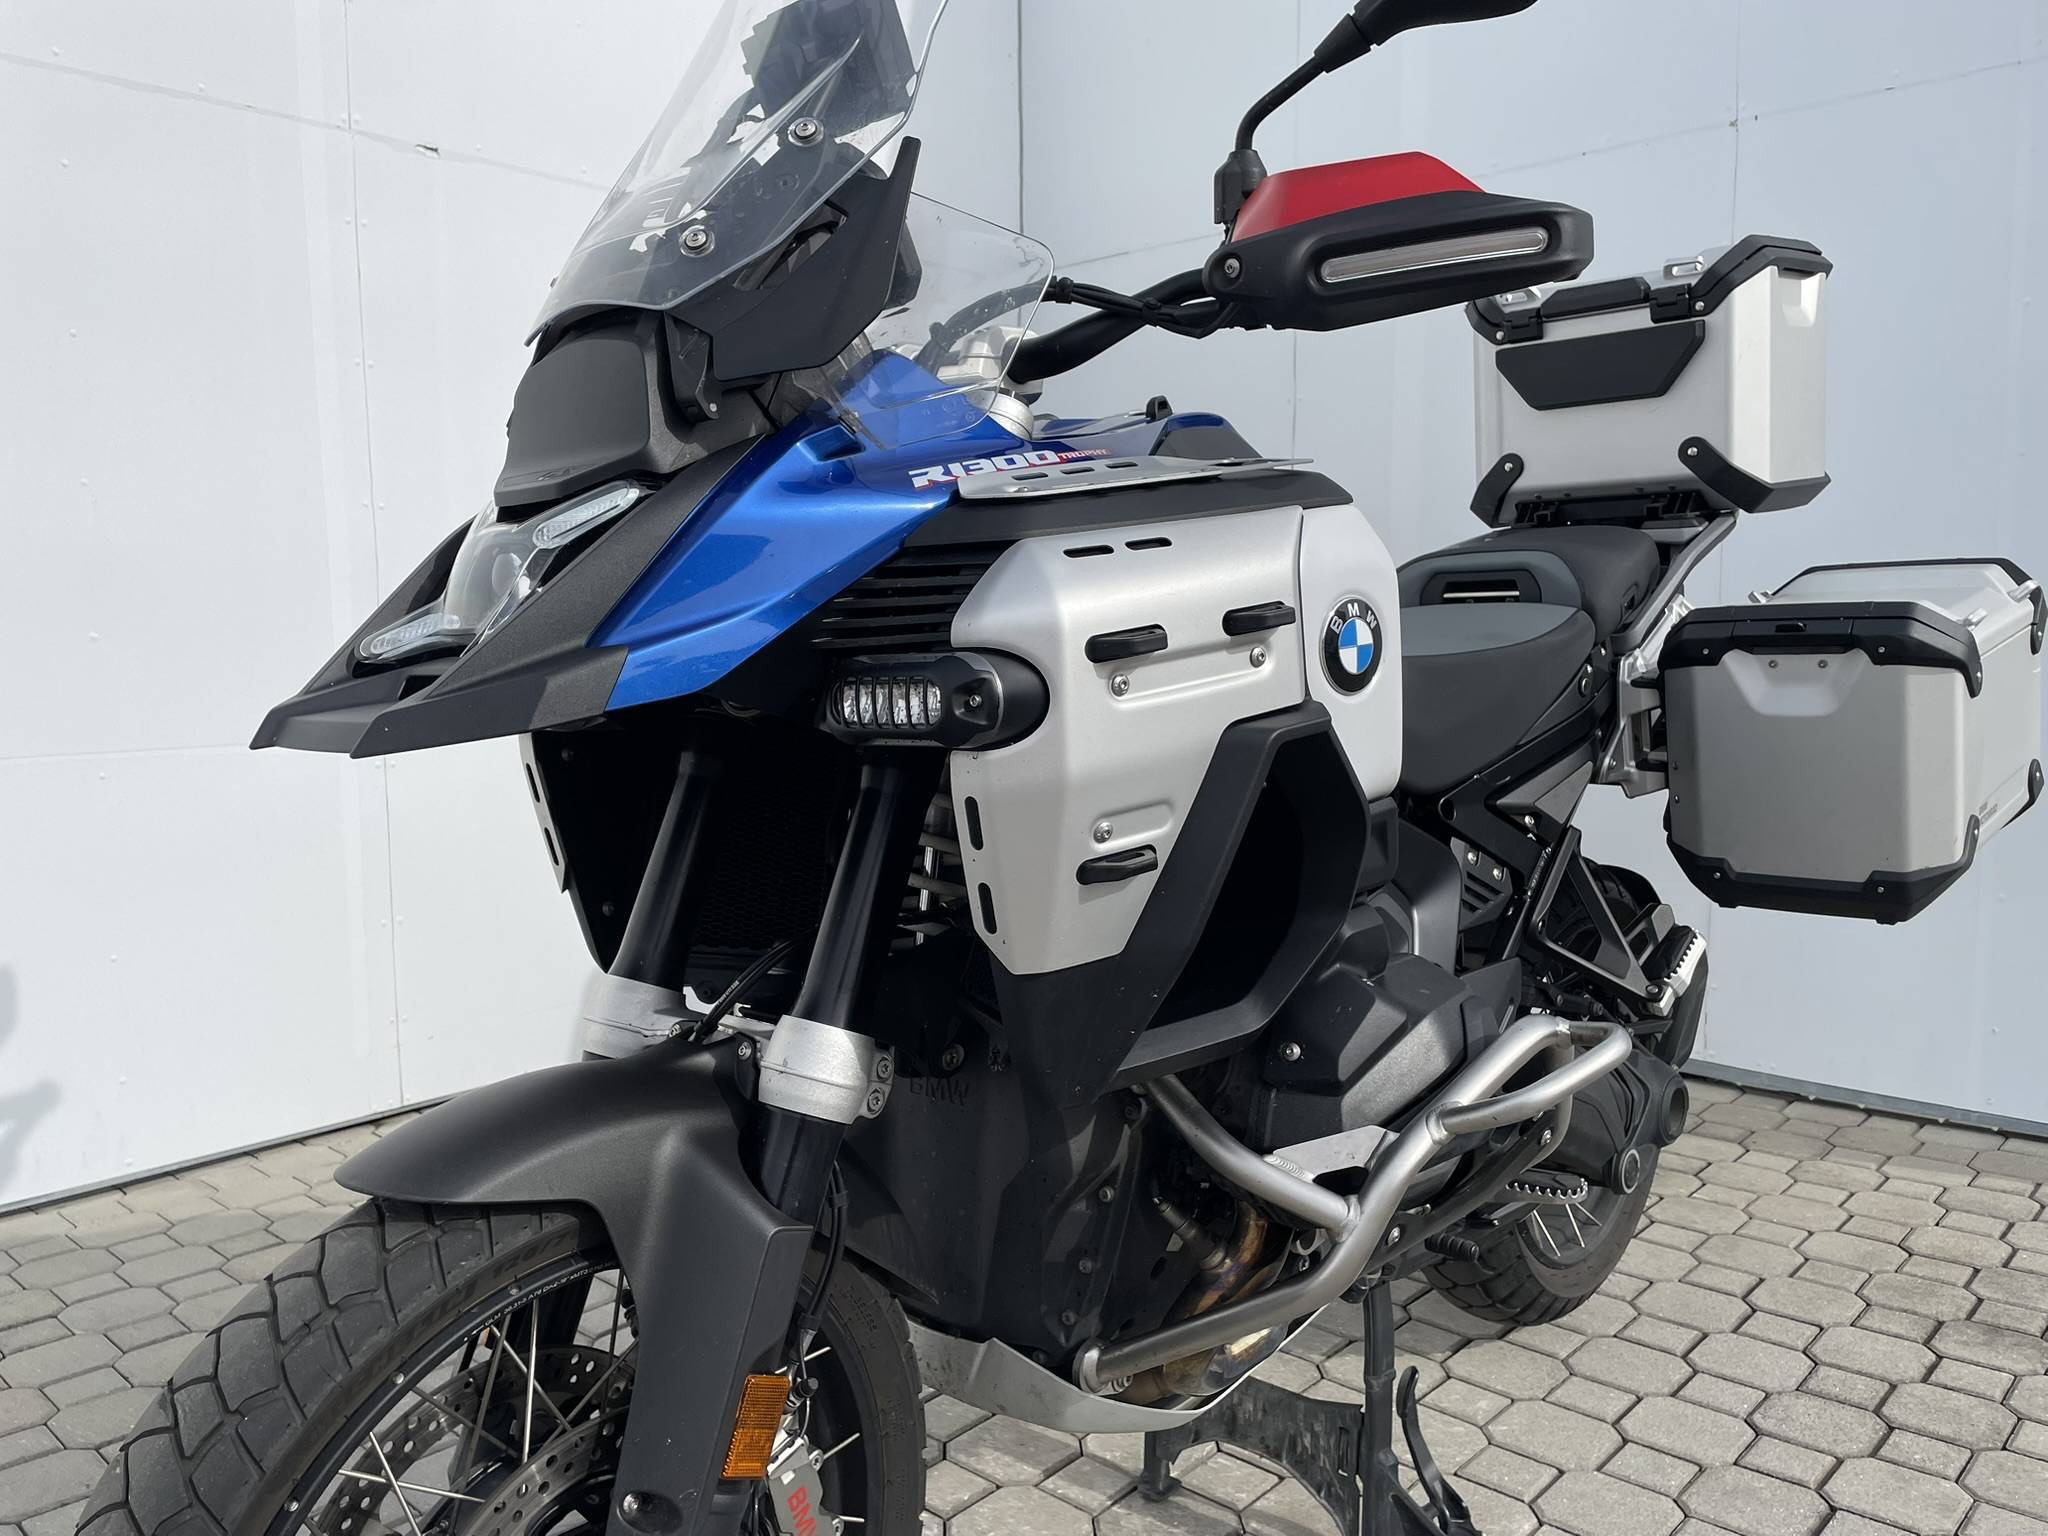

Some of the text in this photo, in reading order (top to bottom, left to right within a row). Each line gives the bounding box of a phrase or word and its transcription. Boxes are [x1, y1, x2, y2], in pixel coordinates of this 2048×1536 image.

[908, 449, 1062, 488] R1300
[1329, 601, 1378, 634] BMW
[786, 1486, 817, 1536] BM
